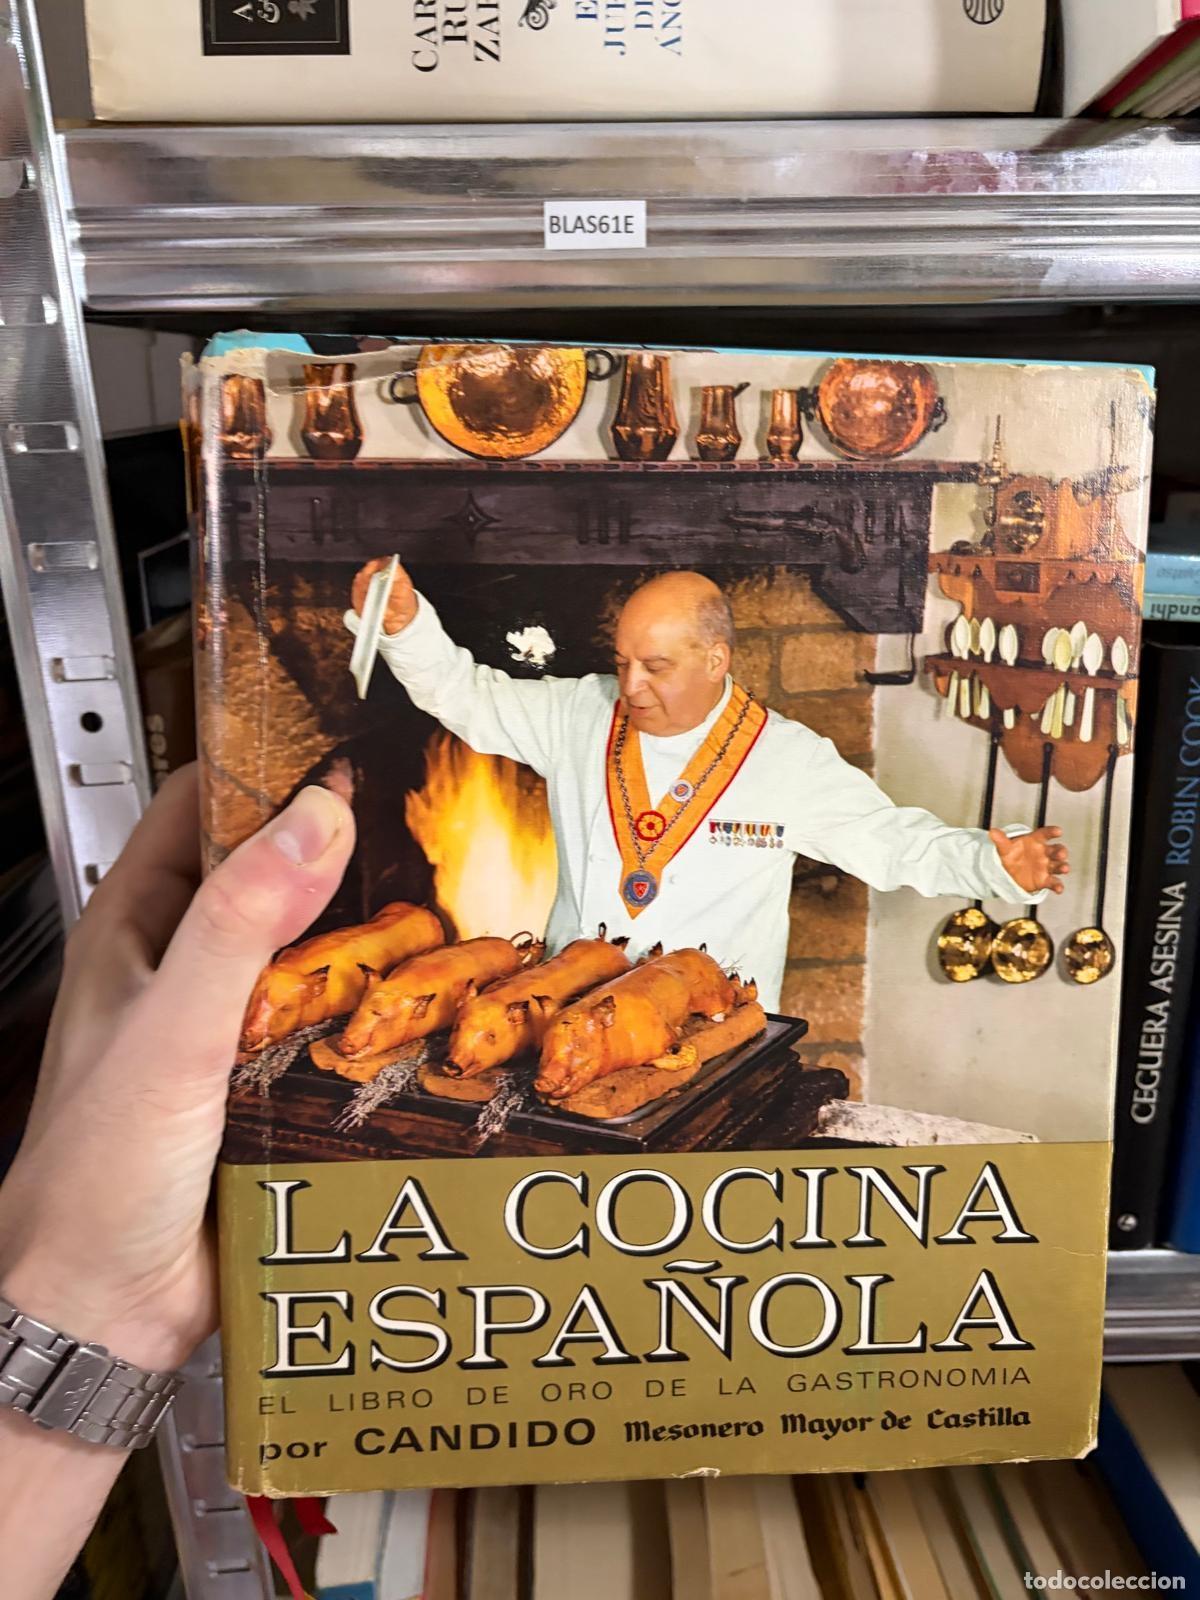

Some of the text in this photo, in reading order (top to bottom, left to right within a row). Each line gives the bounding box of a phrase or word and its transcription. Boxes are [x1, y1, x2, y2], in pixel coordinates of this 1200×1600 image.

[549, 215, 635, 234] BLAS61E
[1165, 776, 1200, 865] ROBIN
[1149, 881, 1187, 994] ASESINA
[1131, 1000, 1170, 1124] CEGUERA
[257, 1161, 1039, 1265] LA COCINA
[258, 1260, 1036, 1379] ESPAÑOLA
[258, 1367, 1031, 1415] EL LIBRO DE ORO DE LA GASTRONOMIA
[258, 1407, 1032, 1468] por CANDIDO Mesonero Mayor de Castilla
